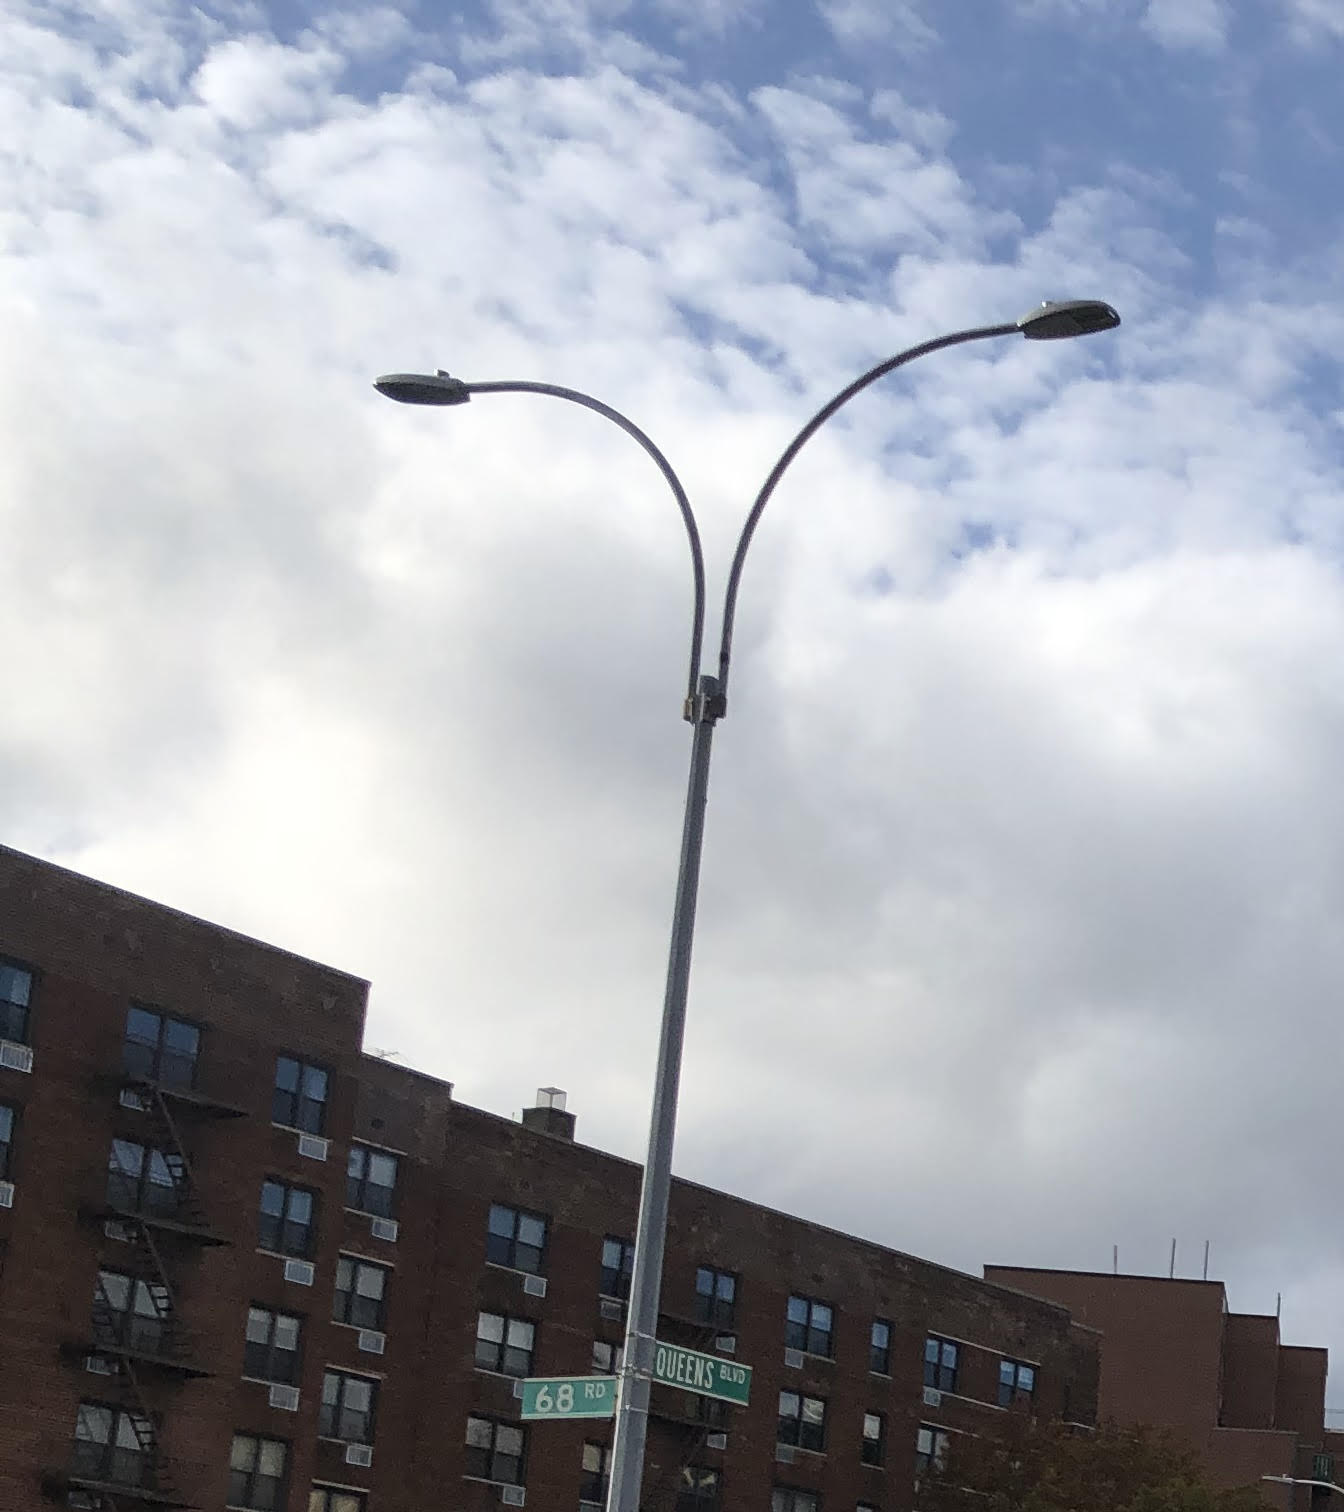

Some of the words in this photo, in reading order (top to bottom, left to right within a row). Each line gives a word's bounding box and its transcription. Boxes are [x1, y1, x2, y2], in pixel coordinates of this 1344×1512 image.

[656, 1349, 714, 1389] QUEENS
[719, 1364, 746, 1385] BLVD
[535, 1384, 574, 1413] 68
[584, 1383, 606, 1399] RD
